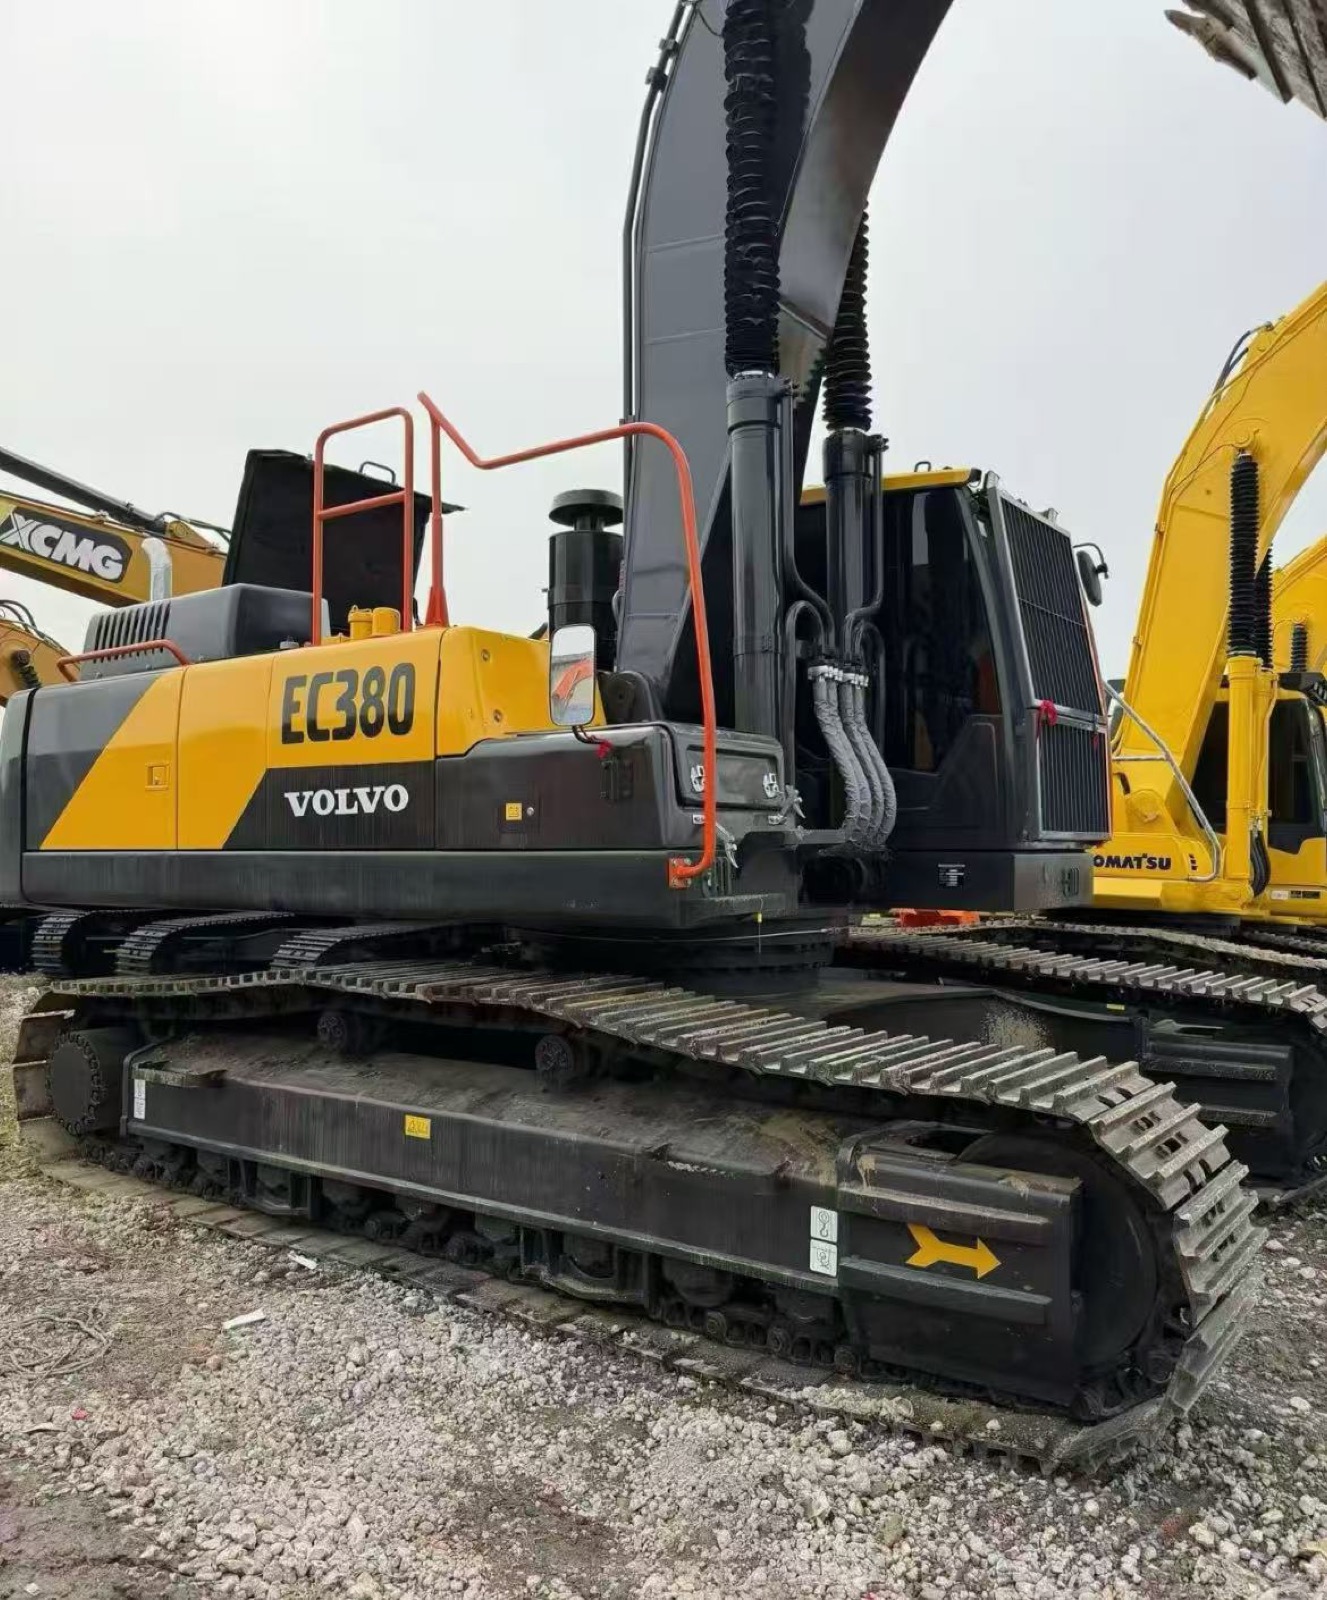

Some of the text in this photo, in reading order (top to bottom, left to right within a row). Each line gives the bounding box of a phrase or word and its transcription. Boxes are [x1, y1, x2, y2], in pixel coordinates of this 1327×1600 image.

[0, 512, 123, 580] XCMG
[281, 662, 416, 744] EC380
[284, 784, 409, 817] VOLVO
[1093, 854, 1171, 870] OMATSU
